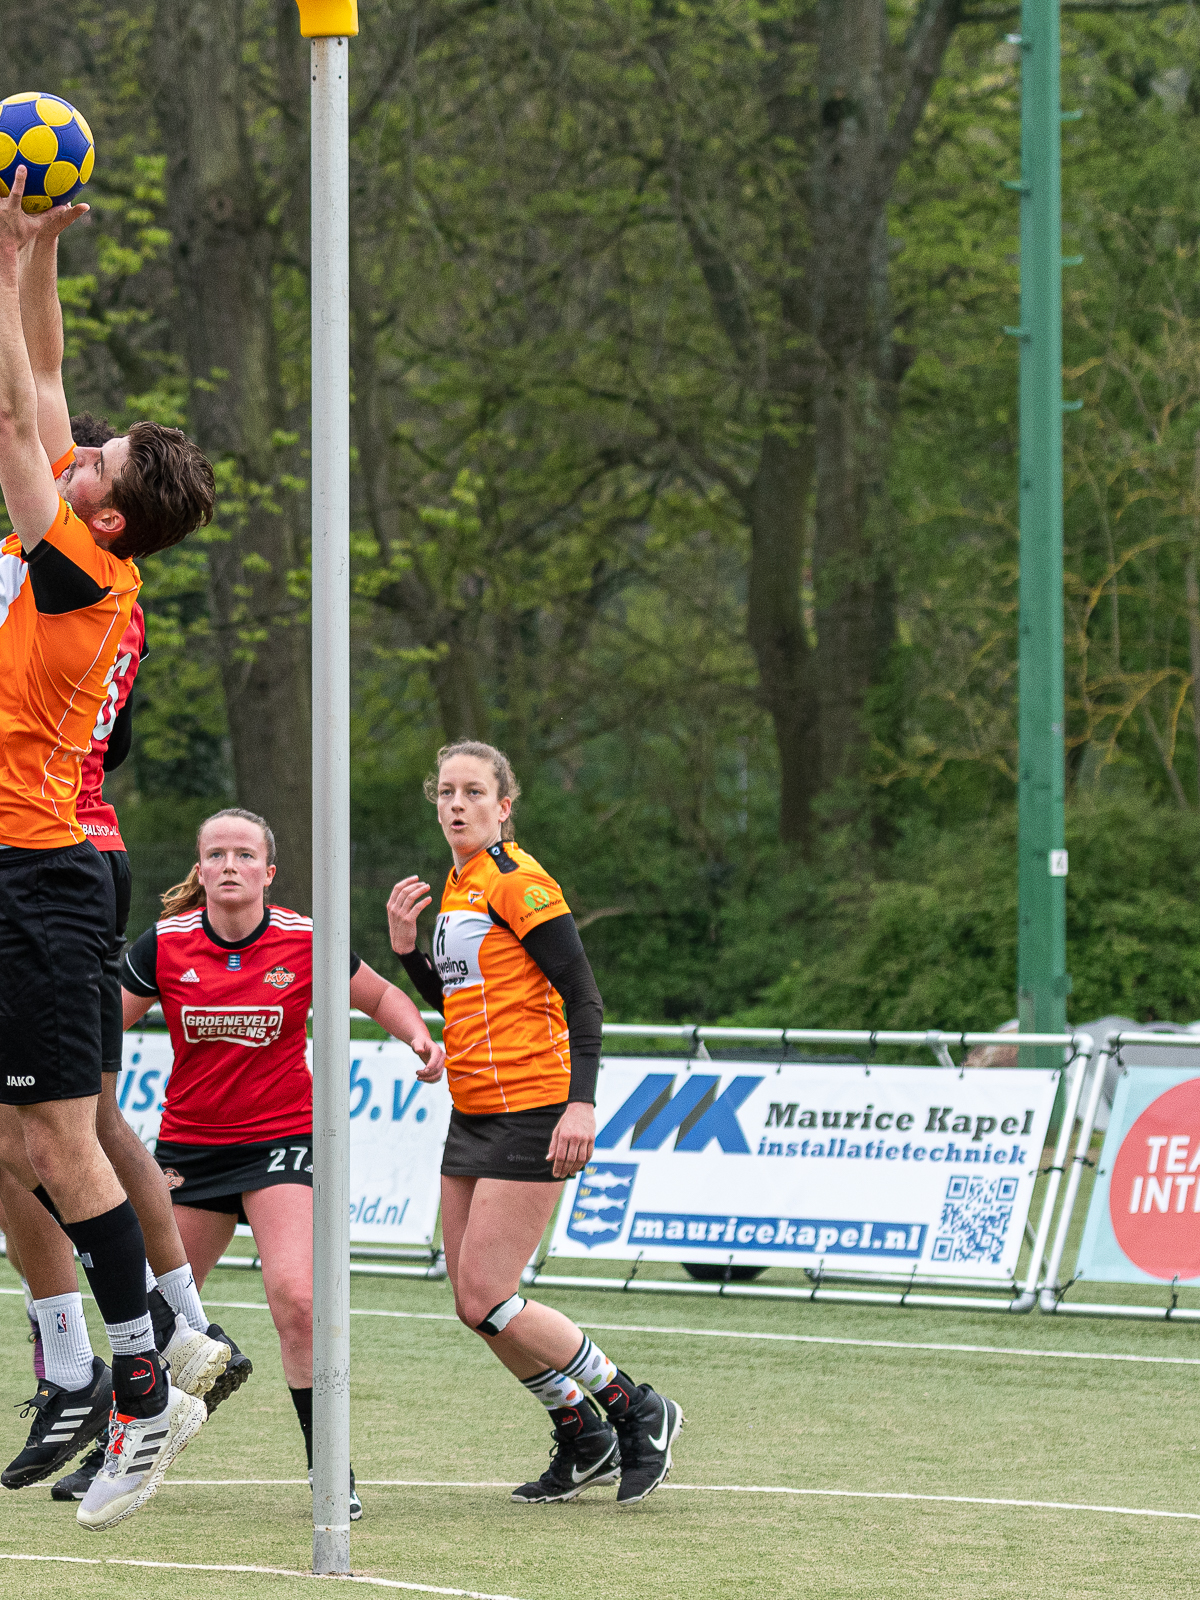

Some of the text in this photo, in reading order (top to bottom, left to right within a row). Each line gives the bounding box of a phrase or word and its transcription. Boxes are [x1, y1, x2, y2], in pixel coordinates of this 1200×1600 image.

[263, 973, 296, 984] KVS
[186, 1015, 279, 1027] GROENEVELD
[197, 1026, 267, 1039] KEUKENS
[6, 1075, 36, 1087] JAKO
[764, 1102, 1035, 1142] Maurice Kapel
[267, 1146, 308, 1172] 27
[757, 1135, 1027, 1165] installatietechniek
[1129, 1175, 1200, 1214] INT
[350, 1196, 411, 1226] eld.nl
[632, 1217, 924, 1252] mauricekapel.nl
